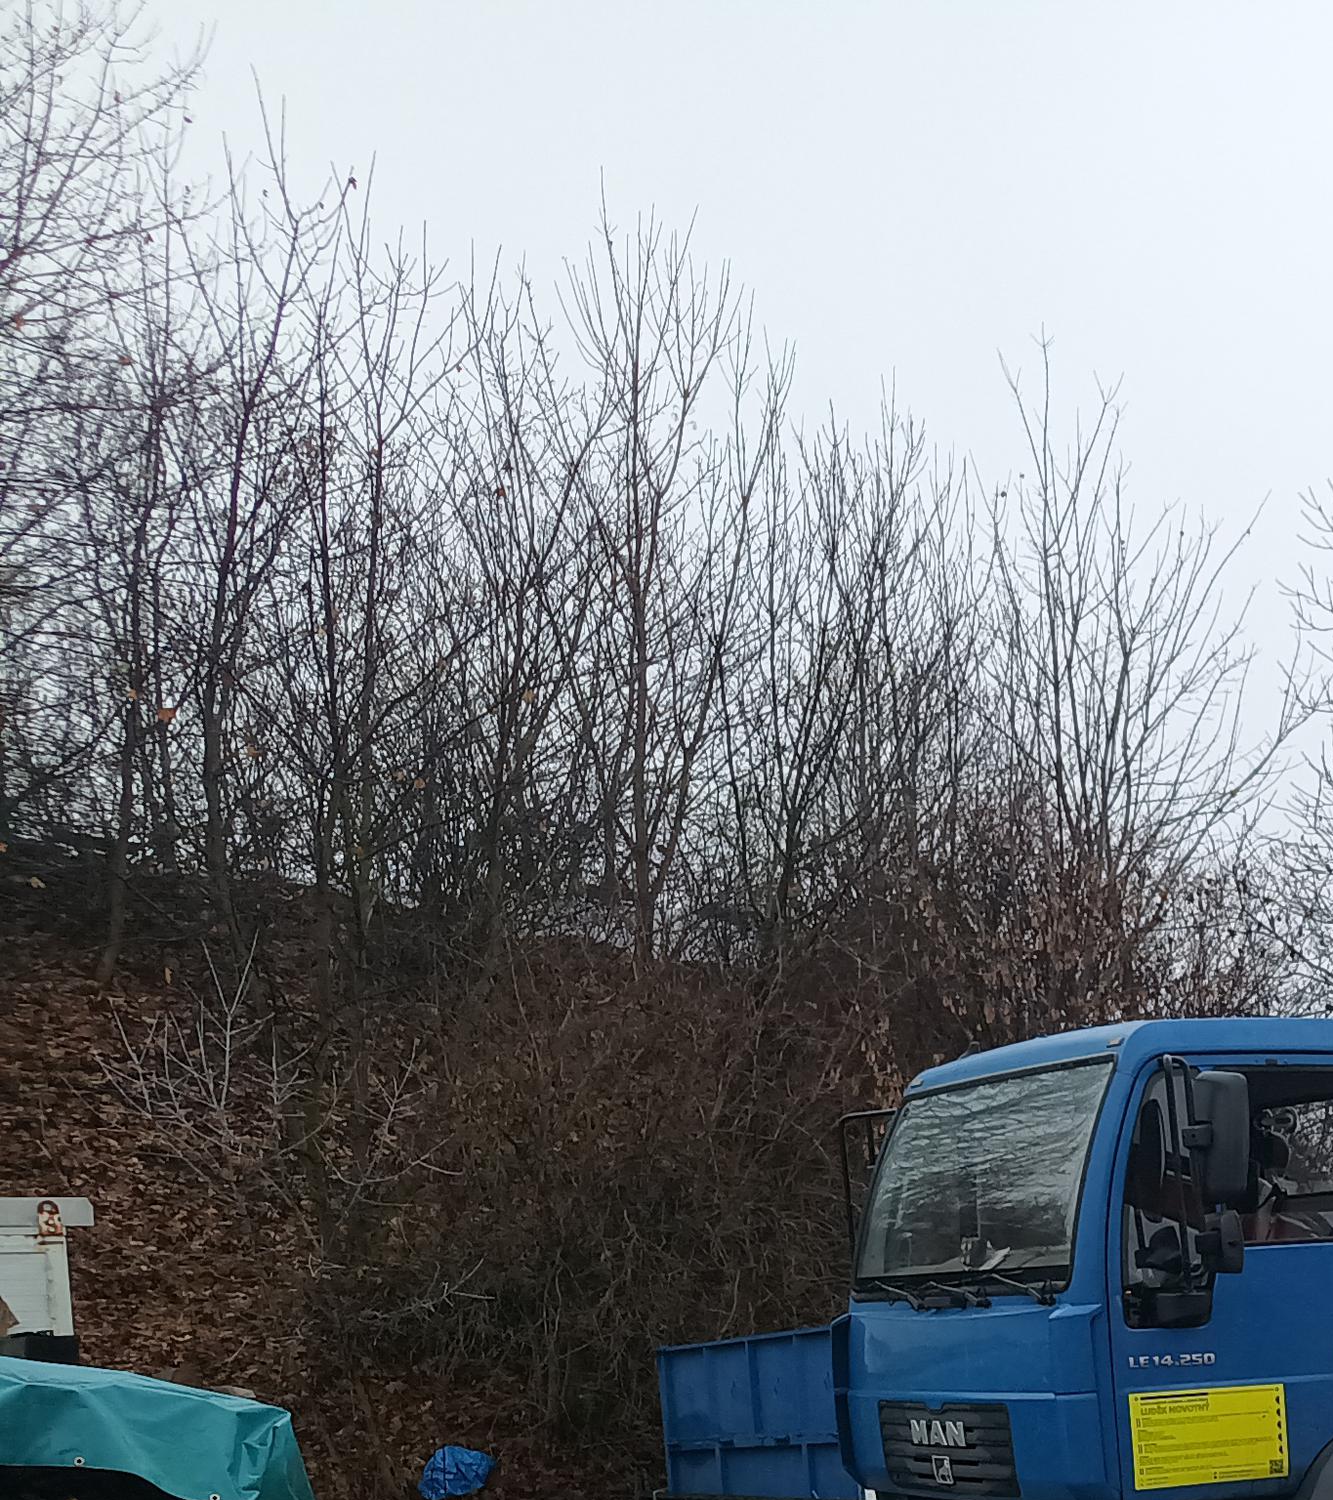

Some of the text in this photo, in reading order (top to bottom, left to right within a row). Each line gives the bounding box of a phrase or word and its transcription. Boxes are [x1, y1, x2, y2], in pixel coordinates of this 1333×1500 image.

[1128, 1352, 1216, 1368] LE 14.250
[909, 1419, 967, 1447] MAN
